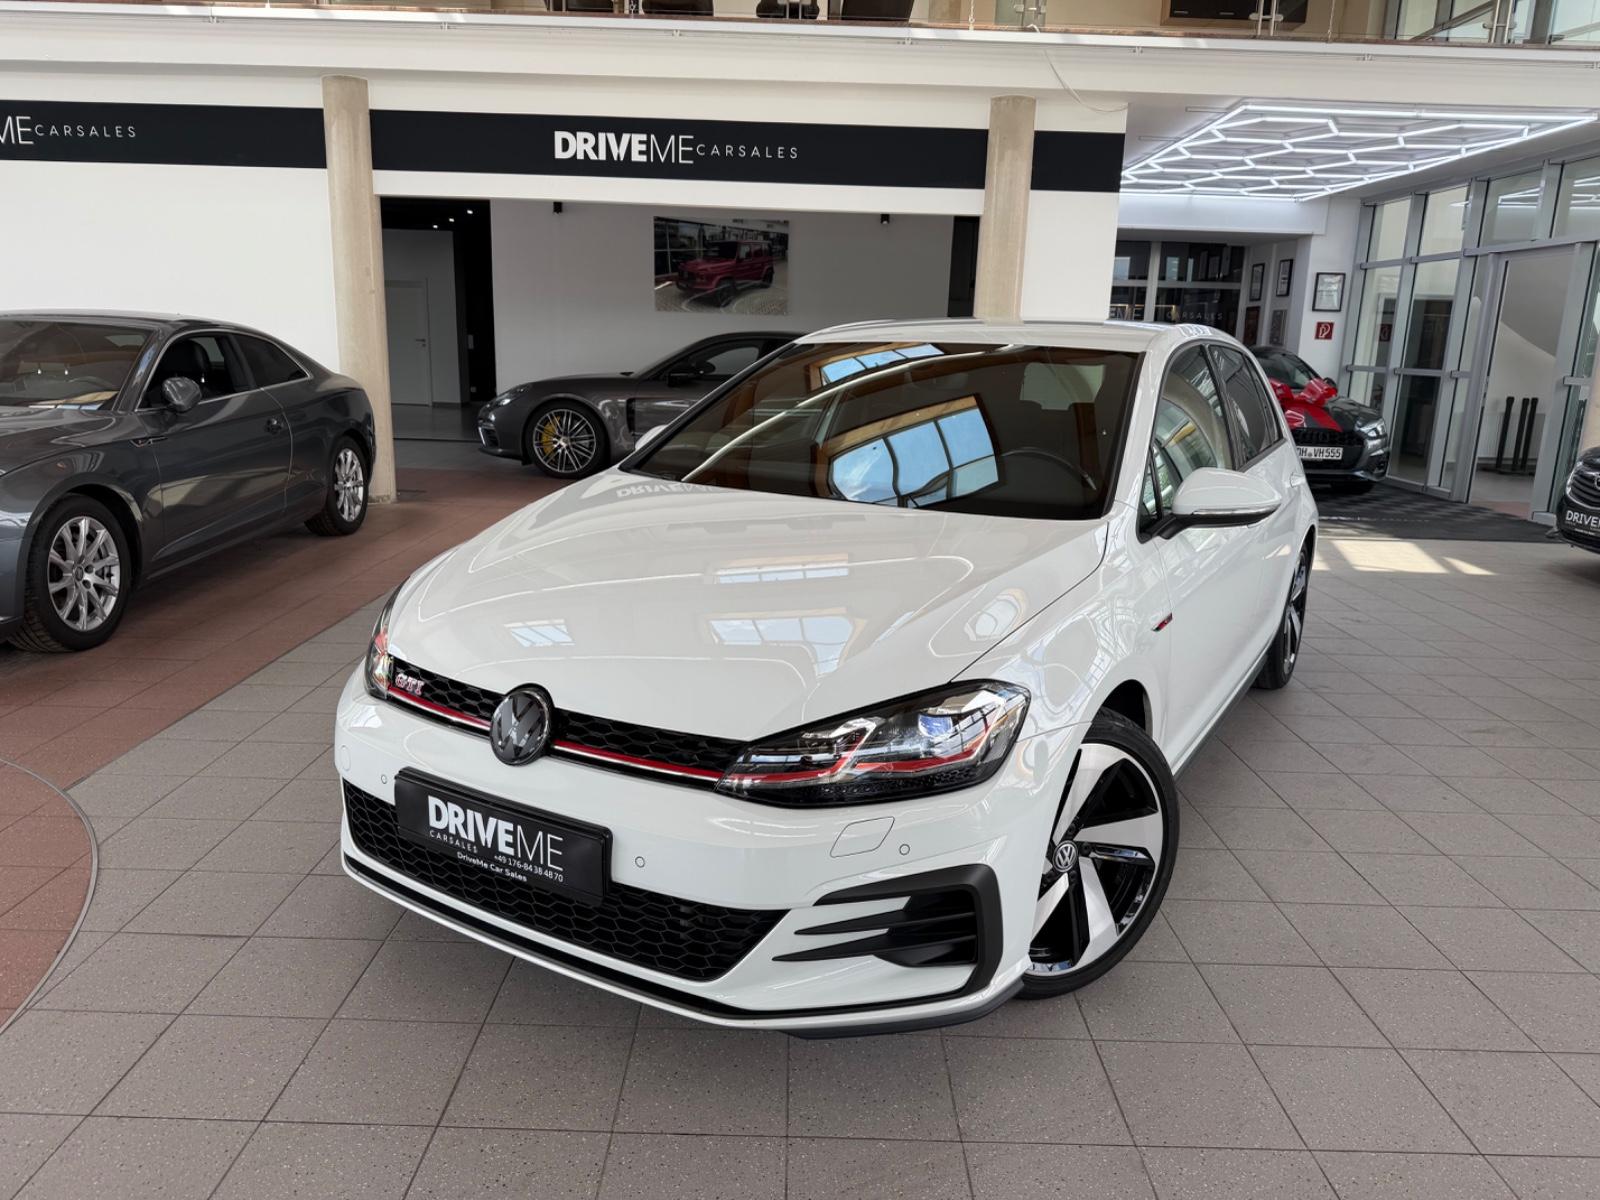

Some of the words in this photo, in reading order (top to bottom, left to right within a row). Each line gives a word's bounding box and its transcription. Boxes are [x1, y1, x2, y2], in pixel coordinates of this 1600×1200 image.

[35, 124, 136, 138] CARSALES
[696, 144, 798, 159] CARSALES
[1566, 510, 1600, 527] DRIVE
[395, 672, 425, 696] GTI
[429, 829, 478, 854] CARSALES
[489, 863, 504, 874] Car
[504, 868, 528, 882] Sales
